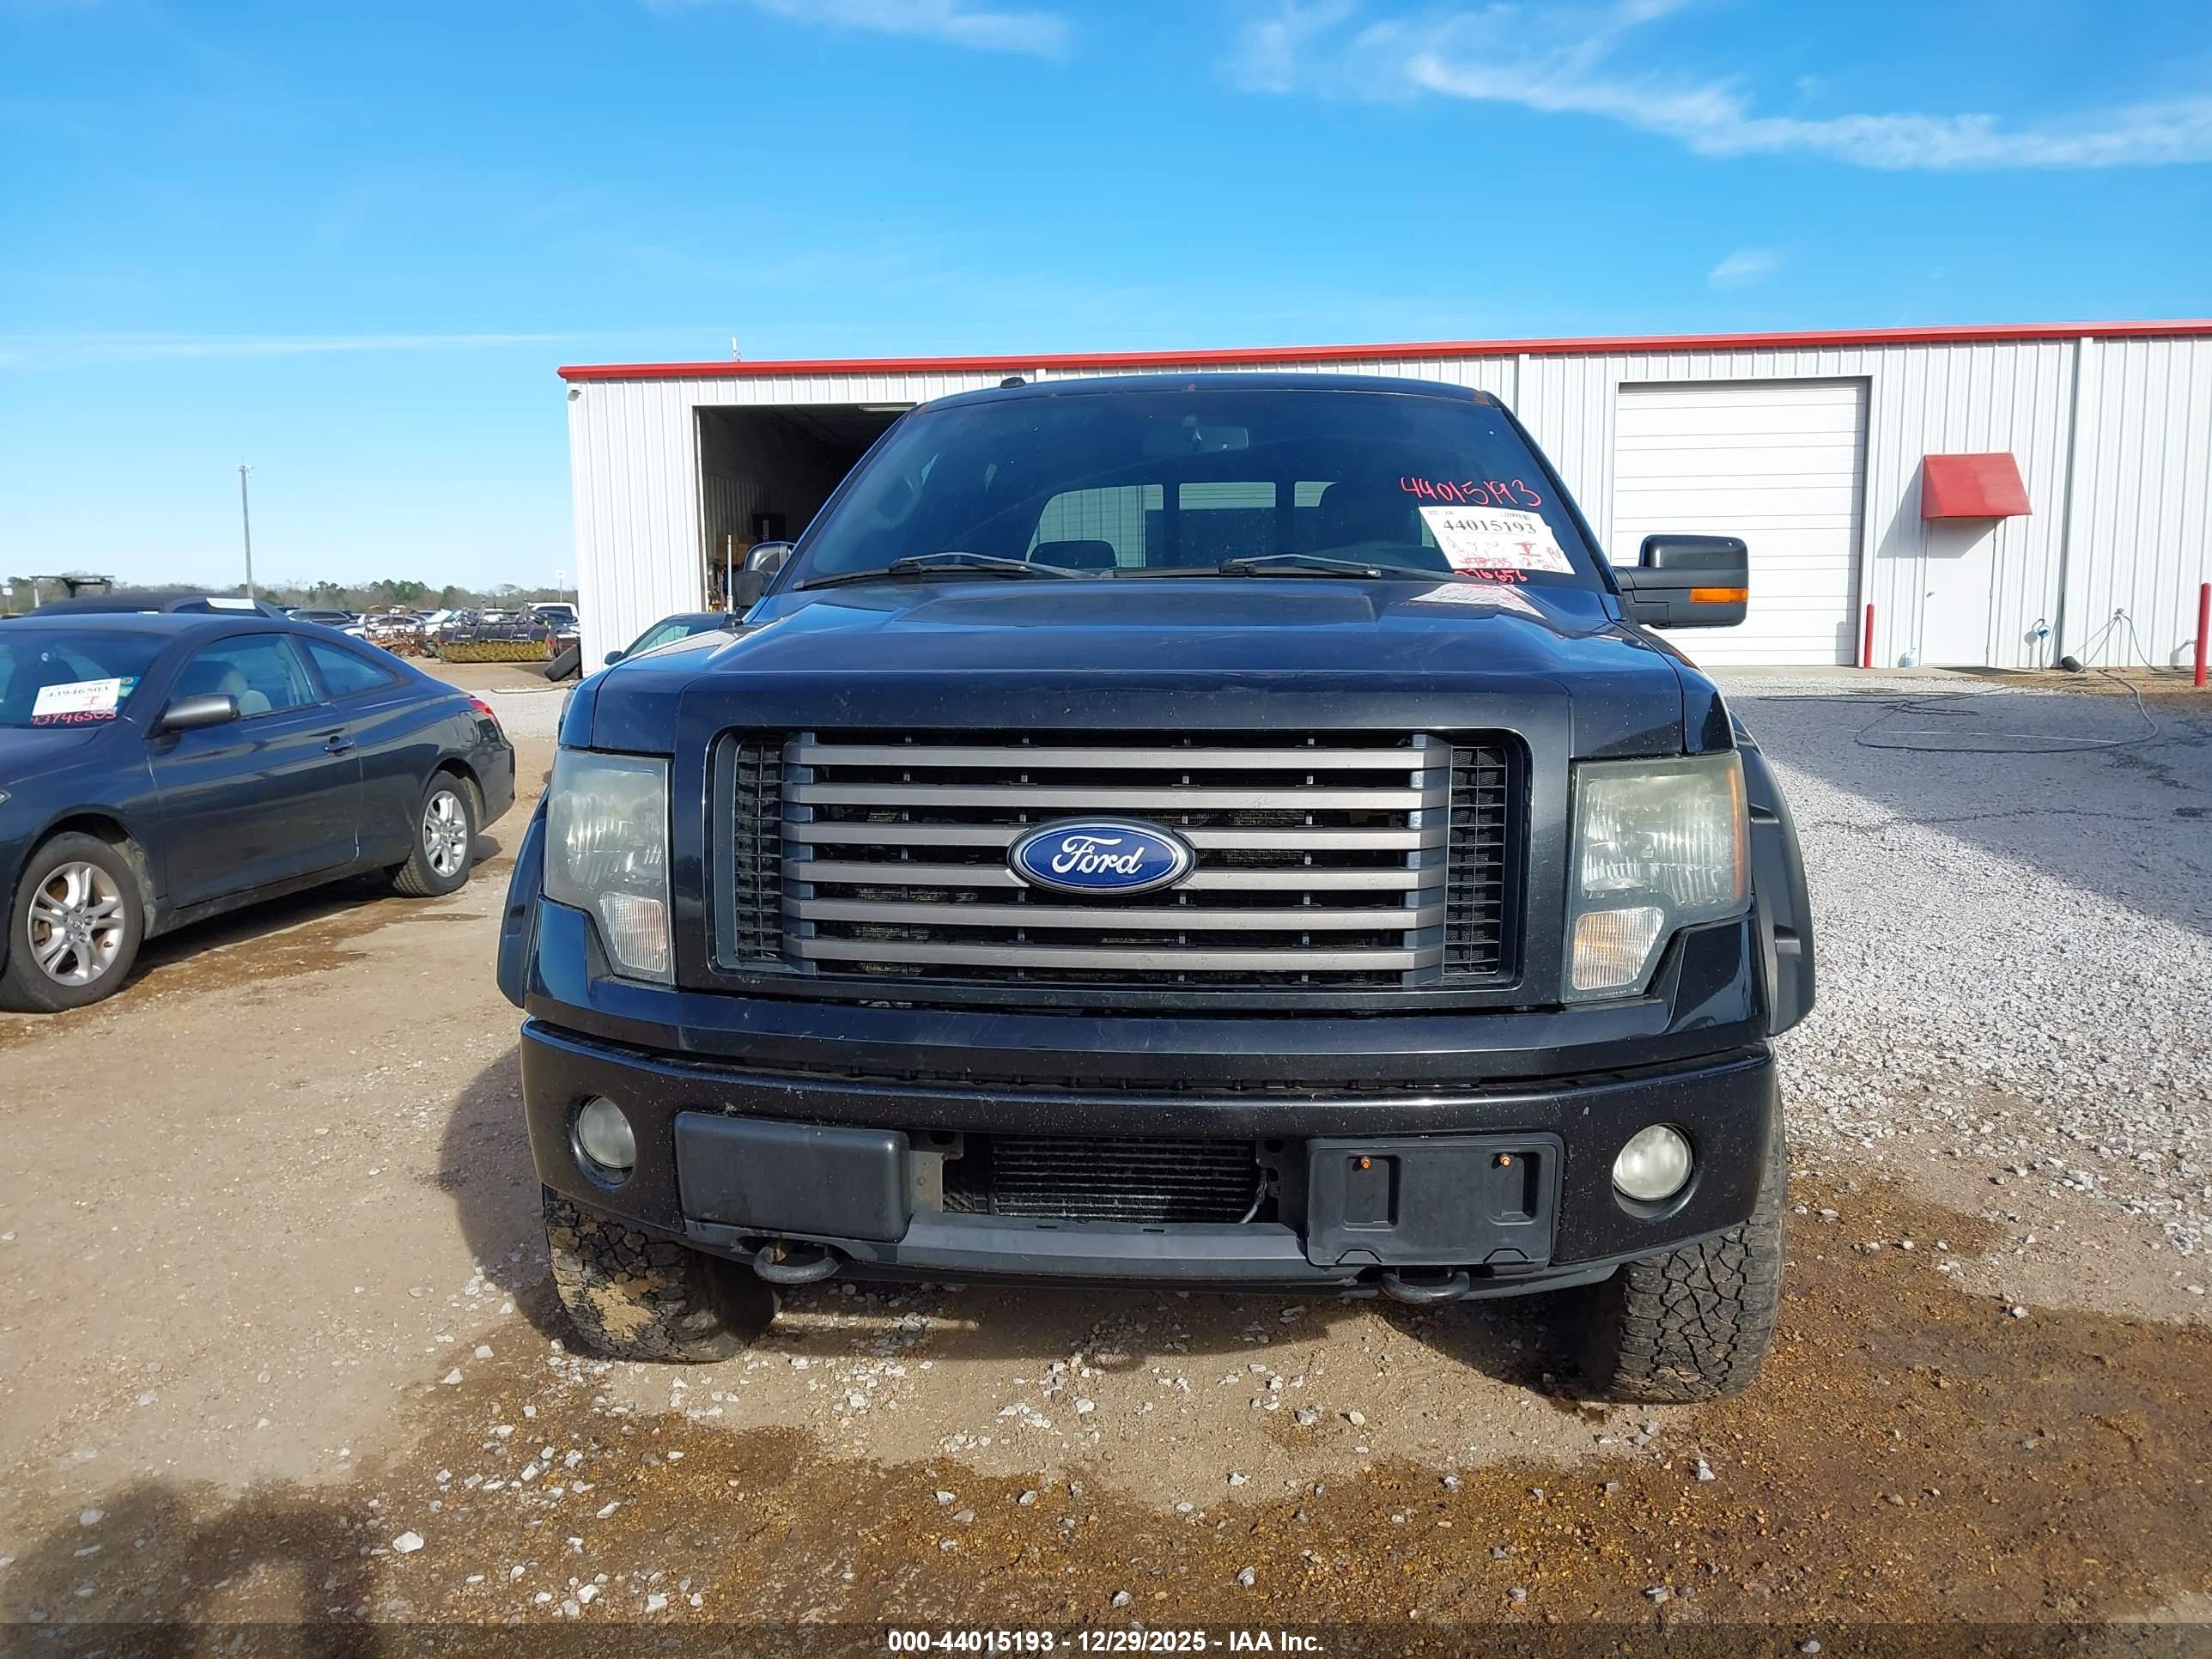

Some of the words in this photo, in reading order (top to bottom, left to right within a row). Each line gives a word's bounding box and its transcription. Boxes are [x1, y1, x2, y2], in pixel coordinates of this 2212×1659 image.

[1401, 477, 1542, 507] 44015193
[1443, 519, 1537, 535] 44015193
[1052, 835, 1146, 875] Ford
